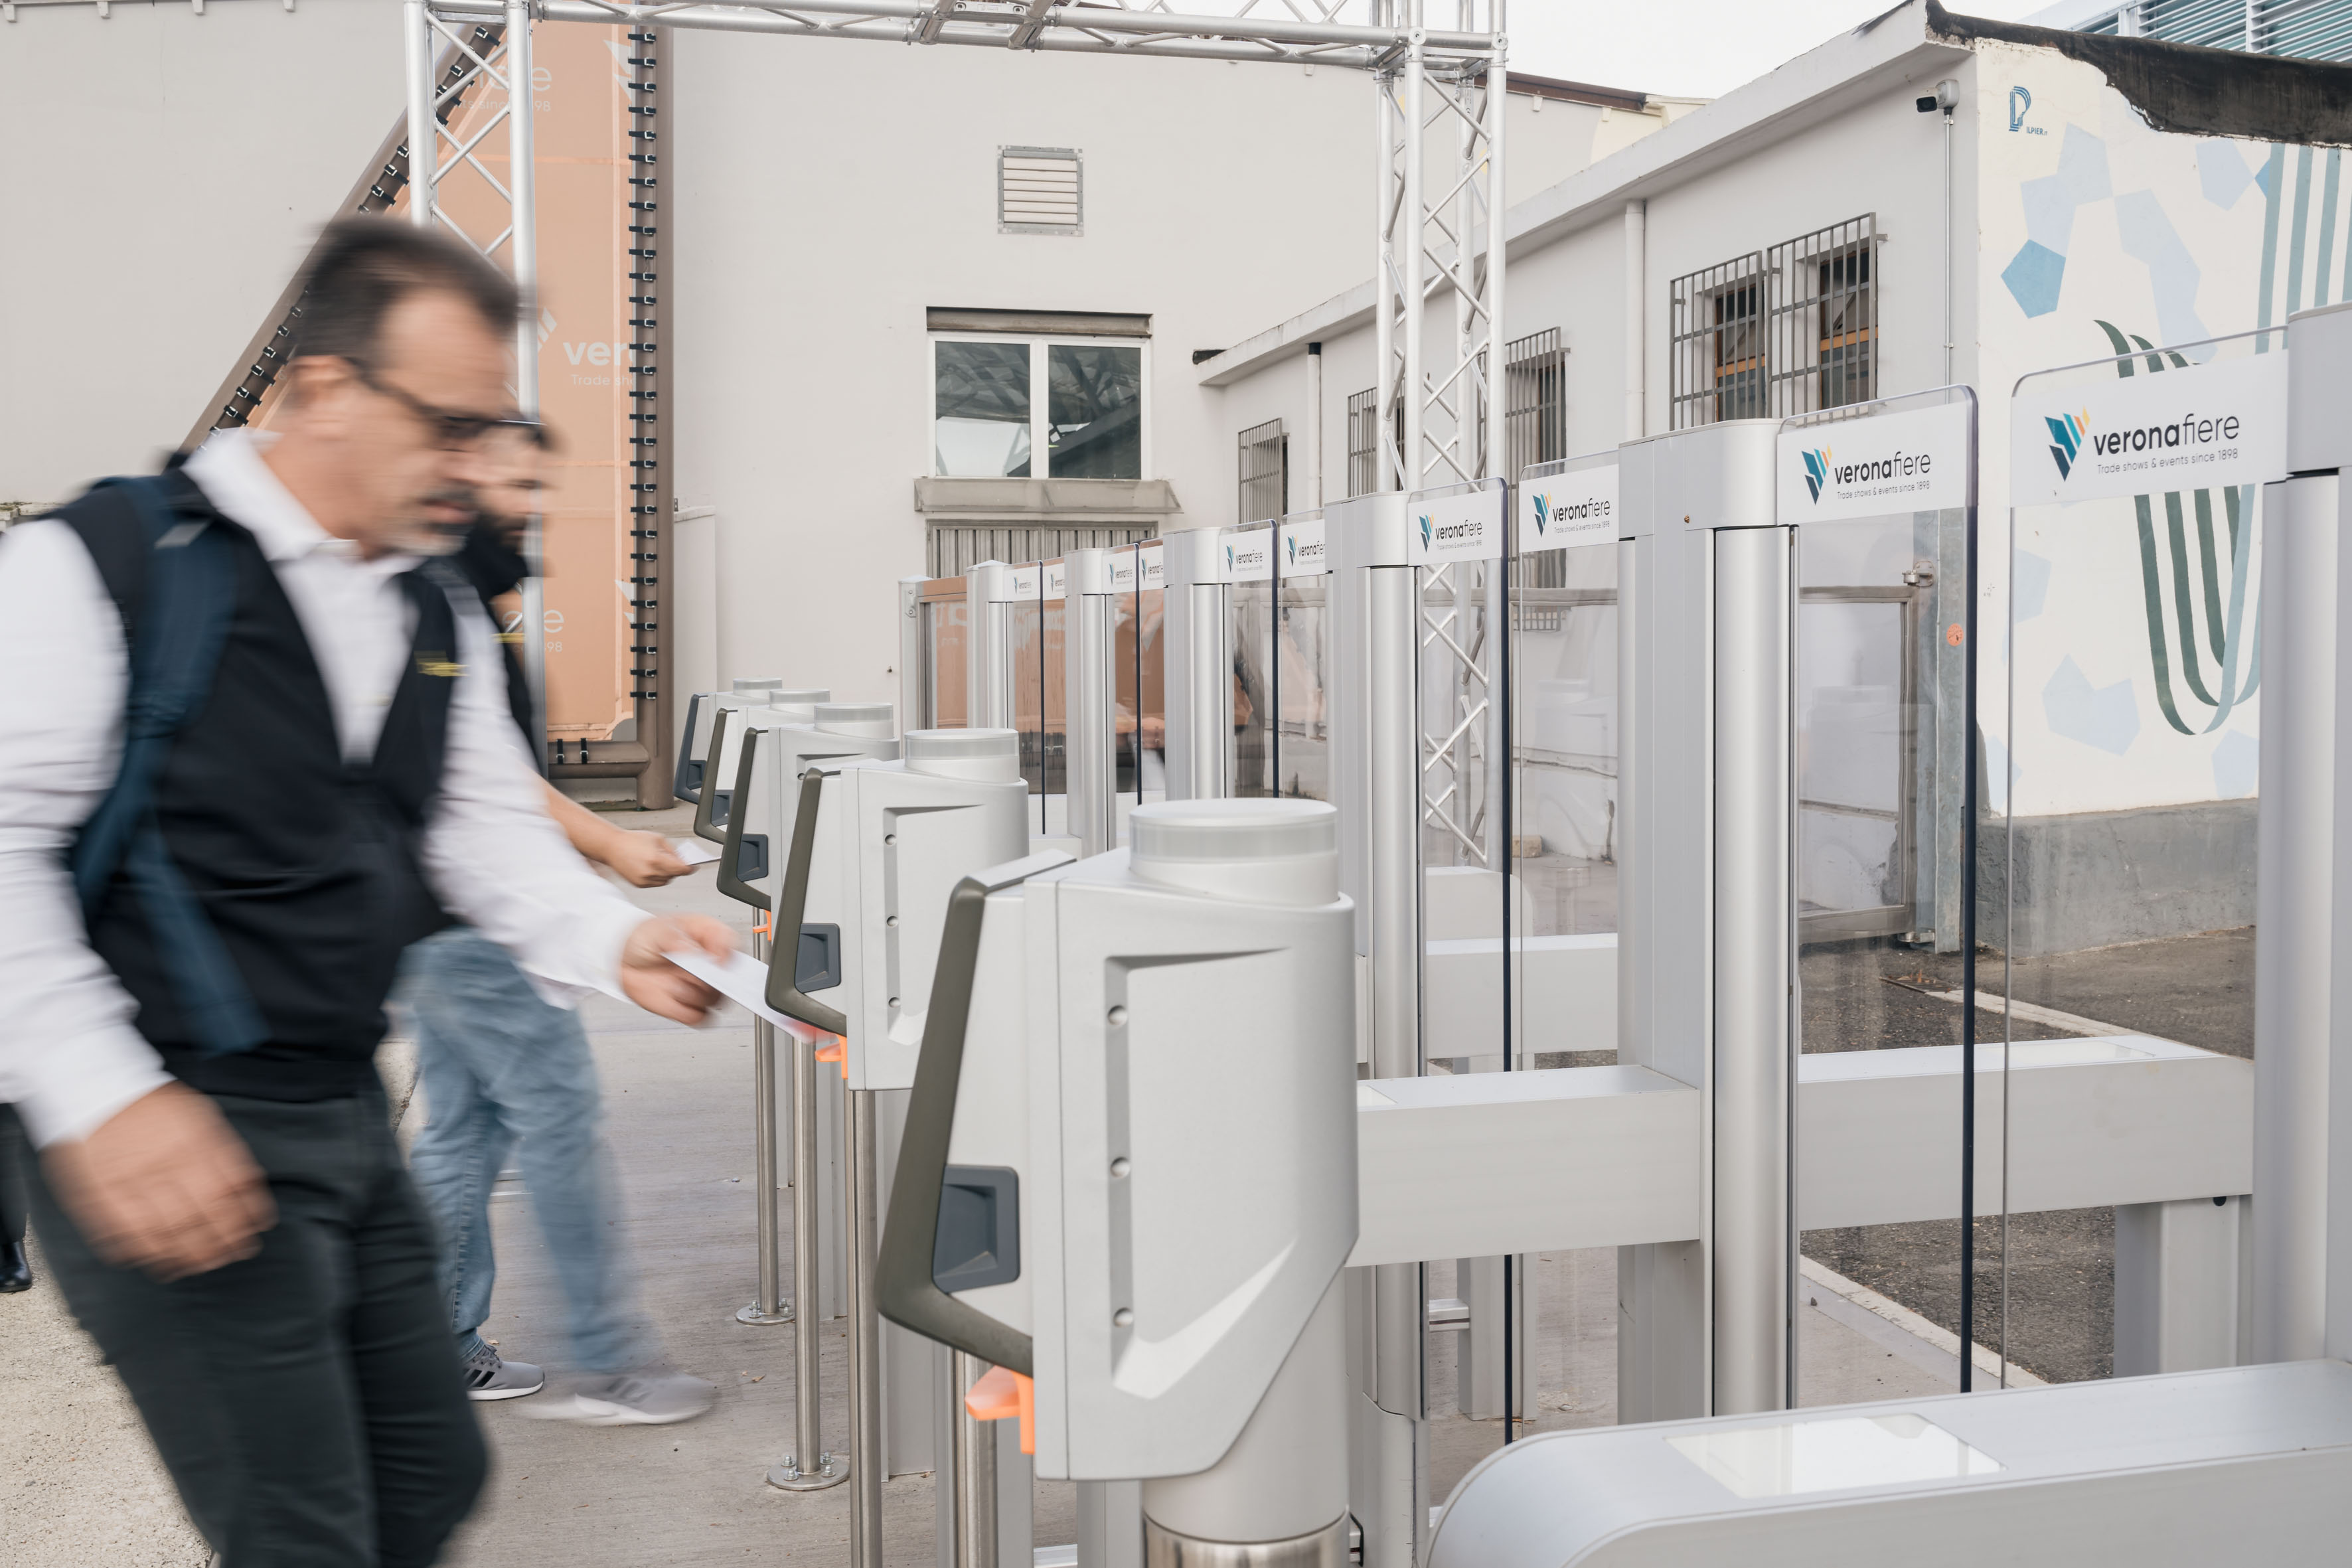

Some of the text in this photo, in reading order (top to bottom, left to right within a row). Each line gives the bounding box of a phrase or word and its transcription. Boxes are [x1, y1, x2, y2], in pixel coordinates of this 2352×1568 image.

[563, 341, 633, 366] ver
[571, 374, 610, 386] Trade
[2094, 413, 2239, 456] veronafiere
[1834, 451, 1930, 485] veronafiere
[2098, 448, 2238, 474] Trade shows & events since 1898
[1553, 498, 1610, 522] veronafiere
[1435, 519, 1482, 540] veronafiere
